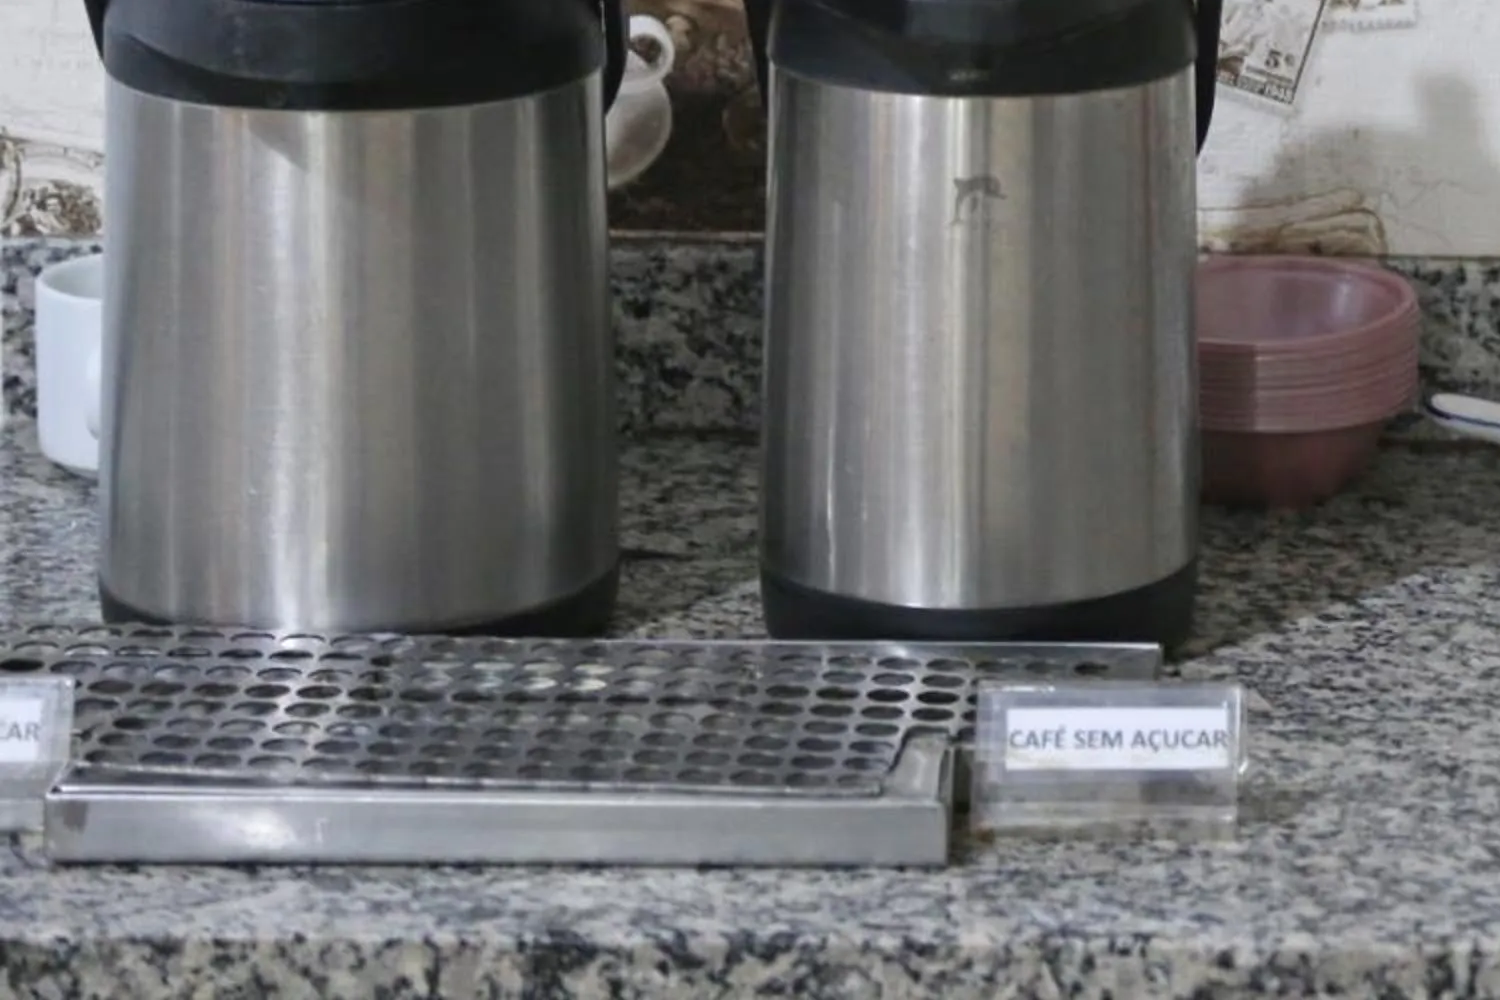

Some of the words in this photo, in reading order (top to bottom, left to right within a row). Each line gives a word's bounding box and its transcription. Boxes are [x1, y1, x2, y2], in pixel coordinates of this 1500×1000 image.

[0, 722, 40, 741] AR
[1009, 724, 1067, 749] CAFÉ
[1073, 729, 1123, 749] SEM
[1130, 729, 1230, 752] AÇUCAR
